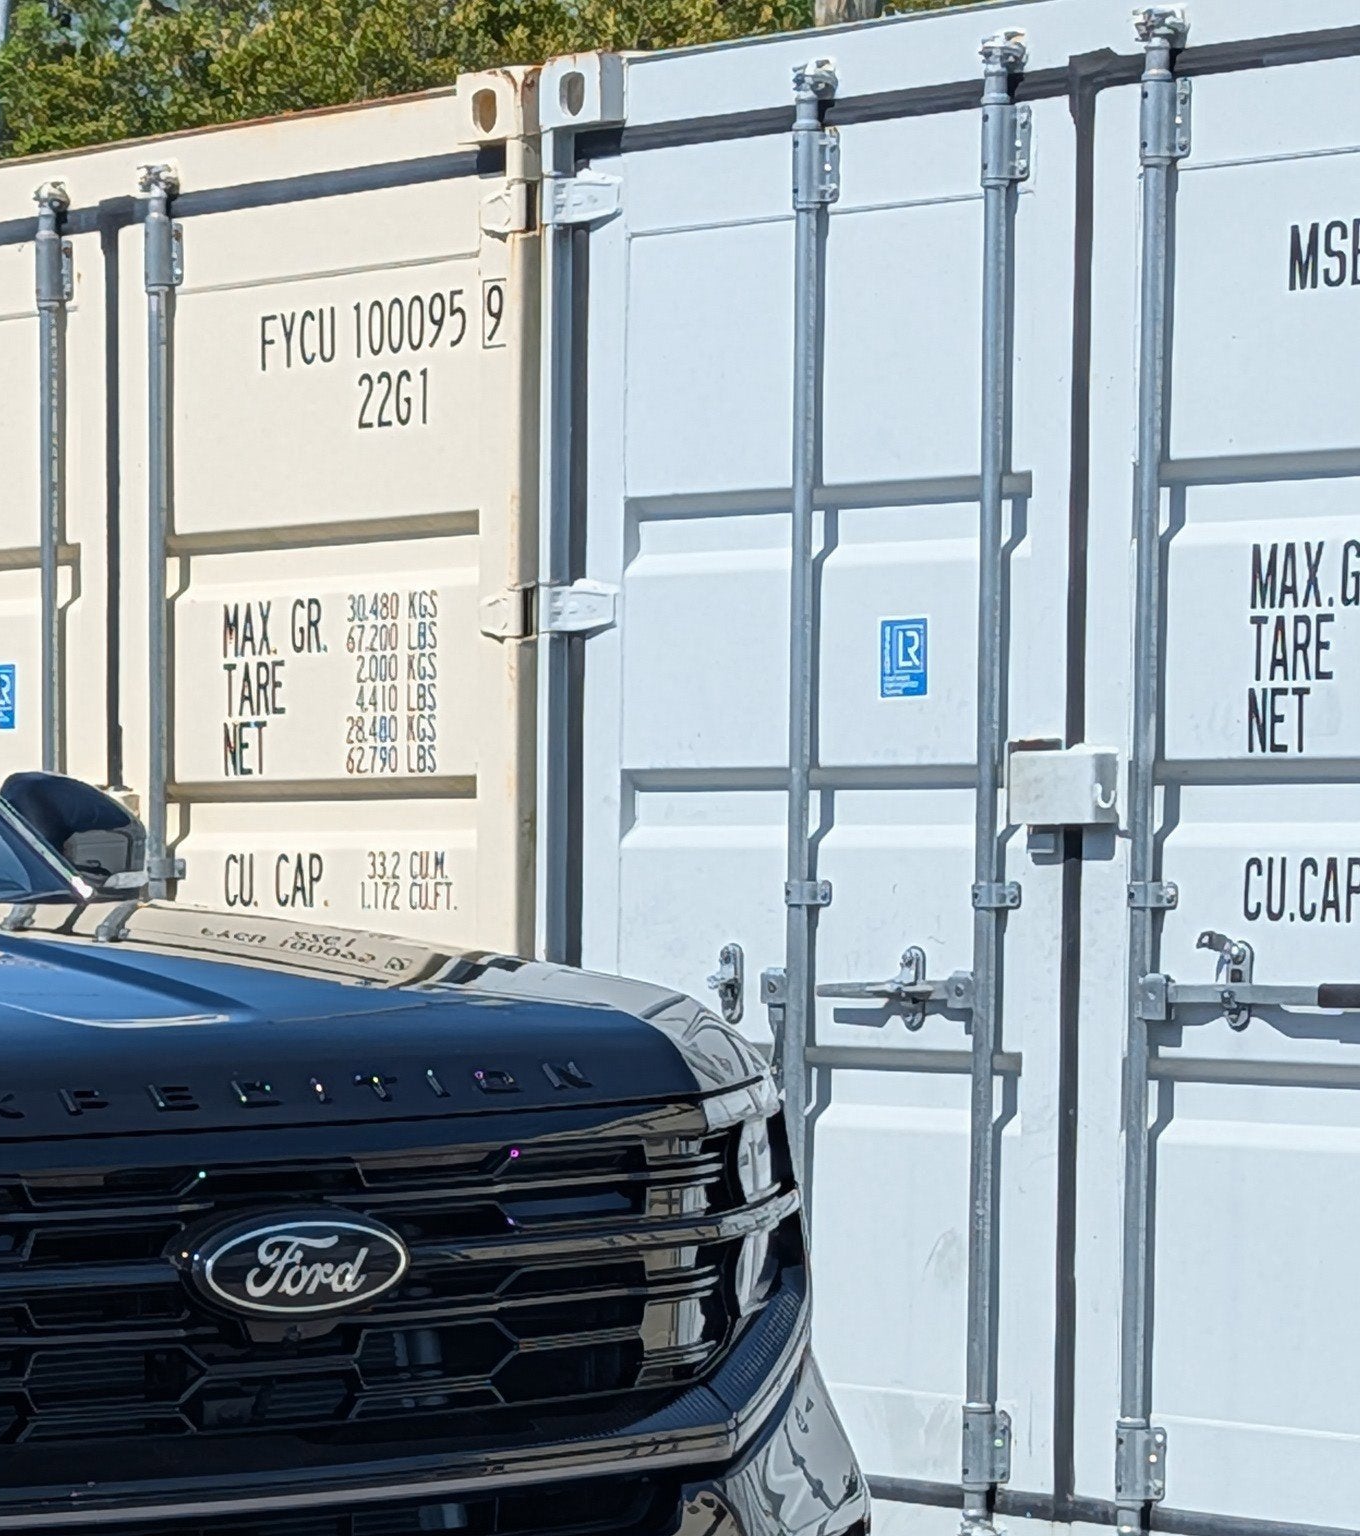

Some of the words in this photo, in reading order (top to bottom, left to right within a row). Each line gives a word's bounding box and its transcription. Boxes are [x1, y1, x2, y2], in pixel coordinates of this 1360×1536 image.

[261, 306, 335, 371] FYCU
[353, 289, 466, 358] 100095
[486, 284, 504, 342] 9
[358, 367, 428, 429] 22G1
[223, 600, 277, 658] MAX.
[290, 598, 328, 653] GR.
[347, 592, 400, 622] 30.480
[408, 590, 438, 619] KGS
[346, 622, 399, 653] 67.200
[408, 621, 438, 650] LBS
[1250, 613, 1335, 681] TARE
[223, 660, 286, 718] TARE
[407, 652, 437, 681] KGS
[407, 683, 437, 712] LBS
[1247, 687, 1311, 753] NET
[223, 720, 268, 777] NET
[407, 713, 437, 743] KGS
[407, 744, 437, 774] LBS
[224, 853, 259, 907] CU.
[275, 852, 331, 908] CAP.
[245, 1235, 369, 1297] Ford
